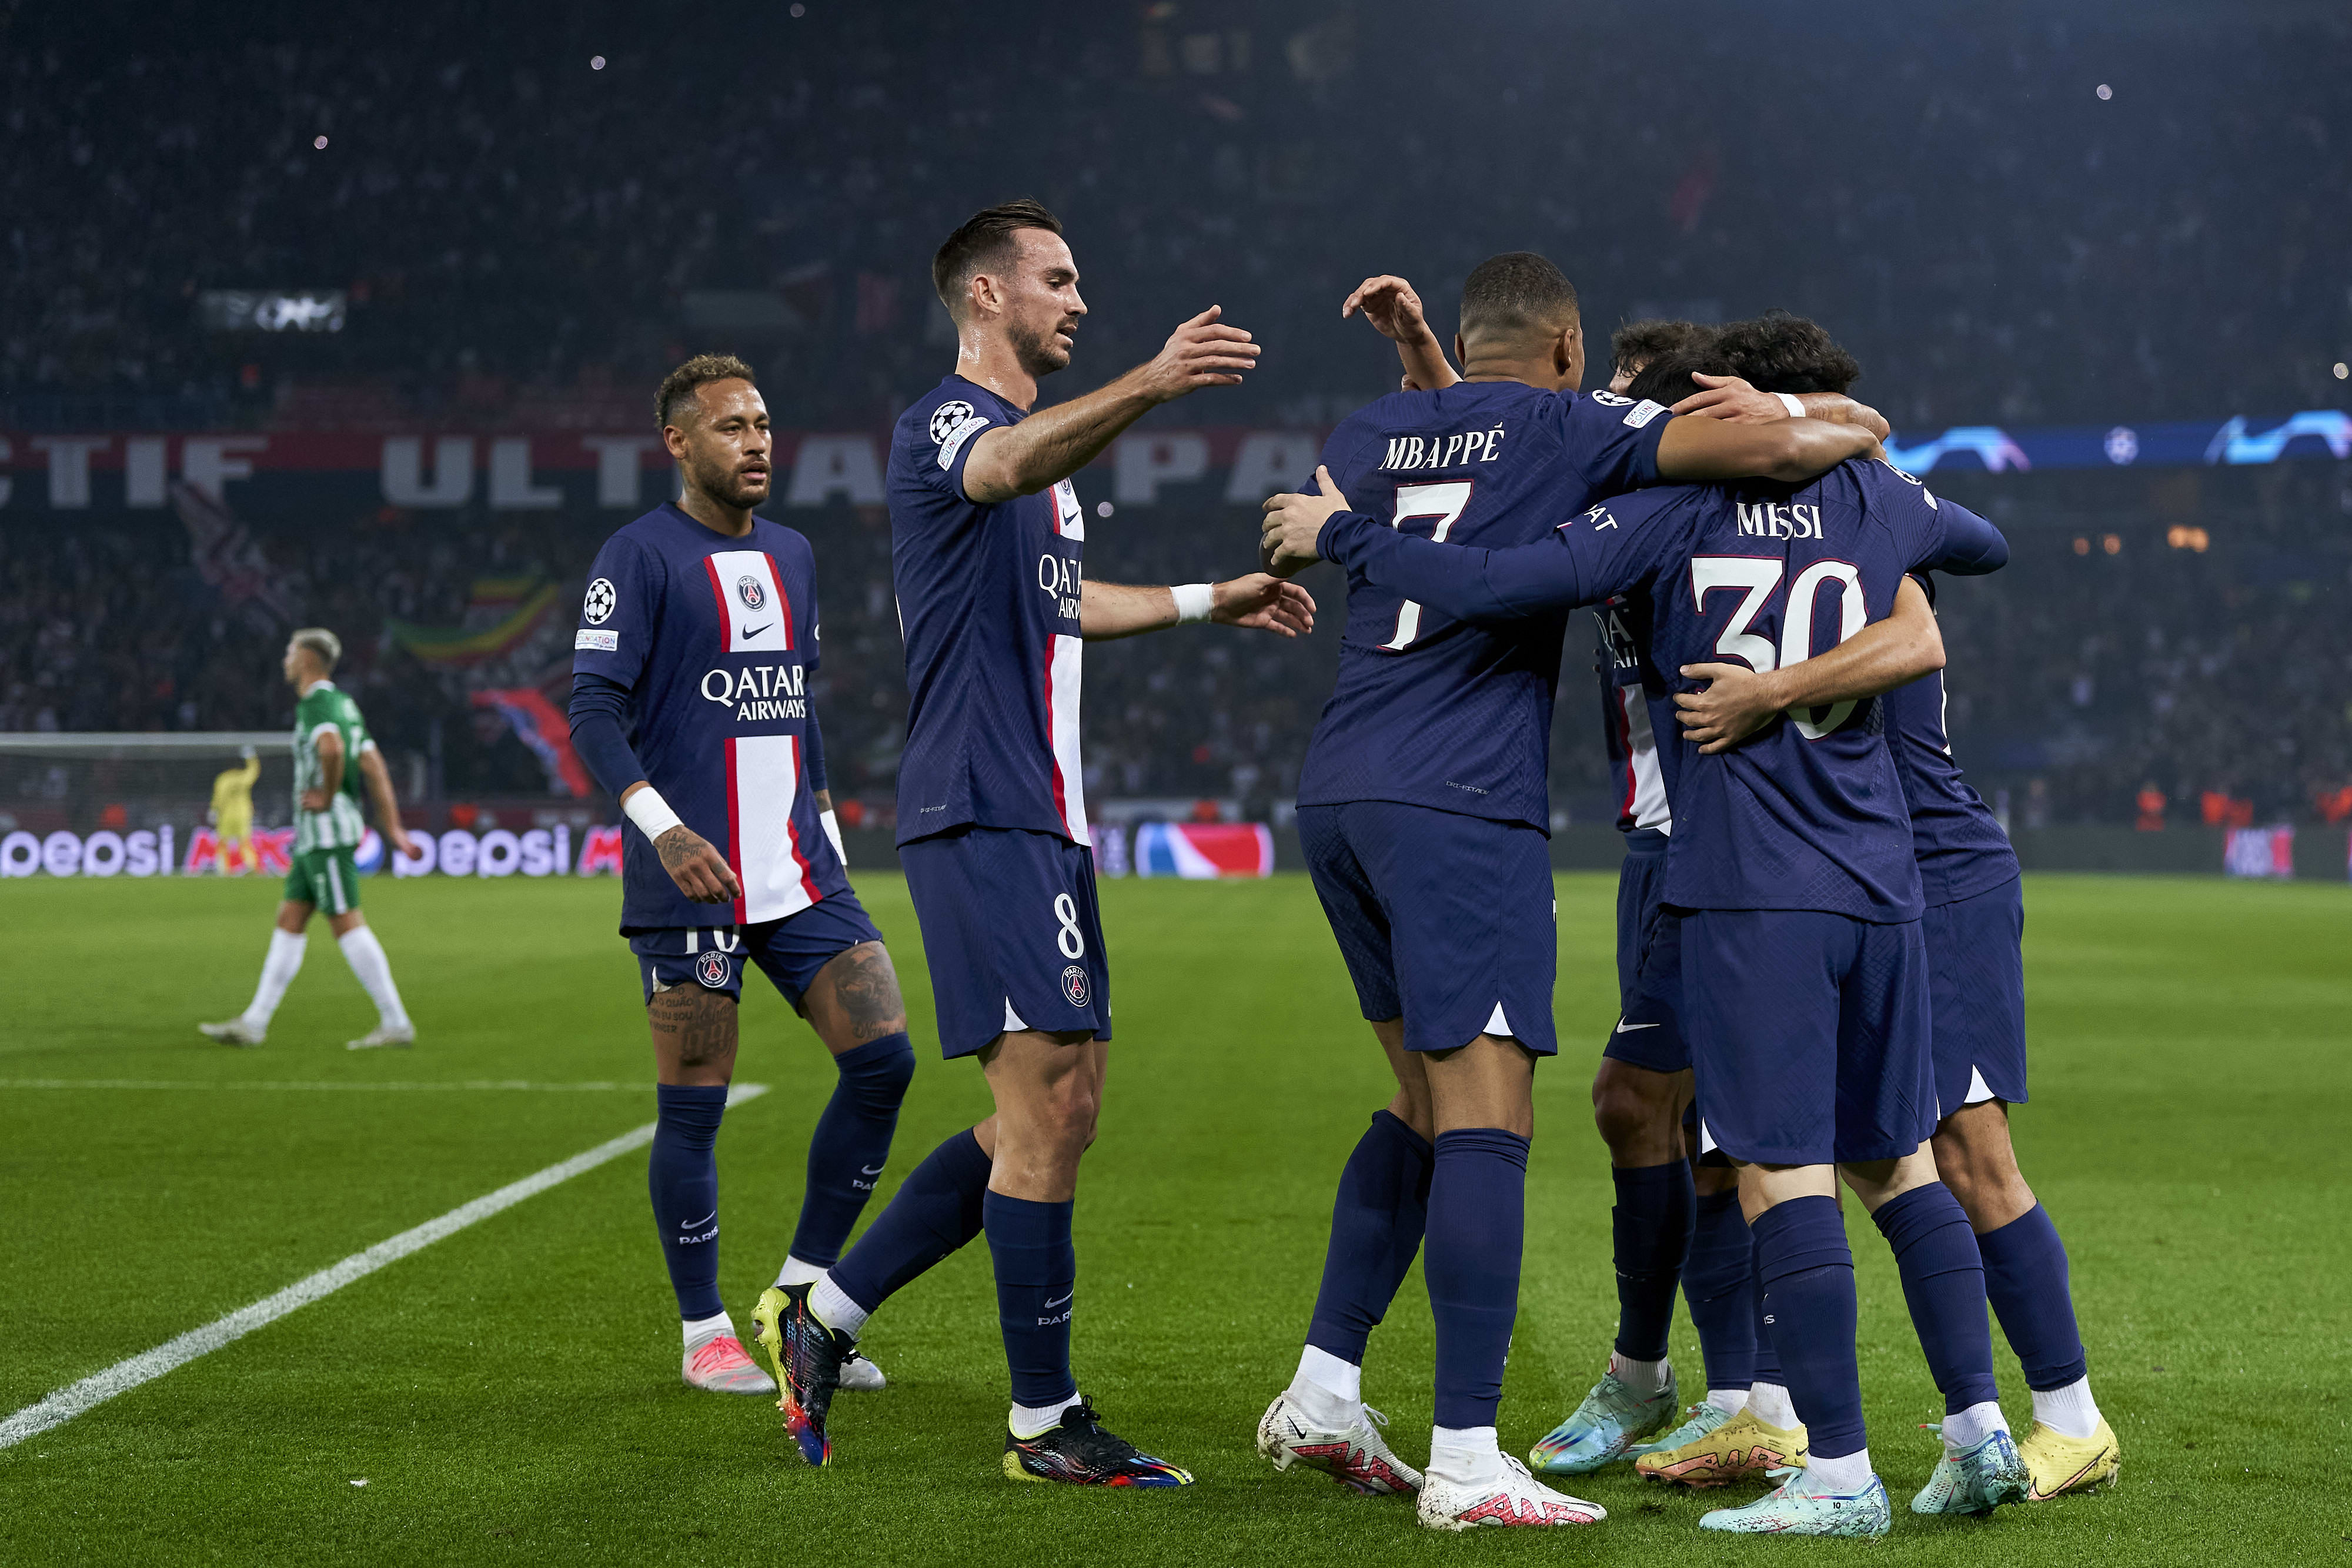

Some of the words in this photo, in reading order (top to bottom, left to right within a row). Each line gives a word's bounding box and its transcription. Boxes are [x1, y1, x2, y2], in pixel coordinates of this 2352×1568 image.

[1378, 421, 1505, 470] MBAPPÉ
[0, 434, 269, 509] TIF
[1736, 502, 1824, 541] MESSI
[1376, 479, 1475, 651] 7
[1690, 554, 1869, 742] 30
[701, 665, 804, 708] QATAR
[736, 698, 806, 721] AIRWAYS
[0, 824, 175, 877] pepsi
[392, 824, 570, 878] pepsi
[1054, 892, 1085, 959] 8
[700, 953, 723, 964] PARIS
[1064, 968, 1084, 978] PARIS
[679, 1225, 719, 1245] PARIS
